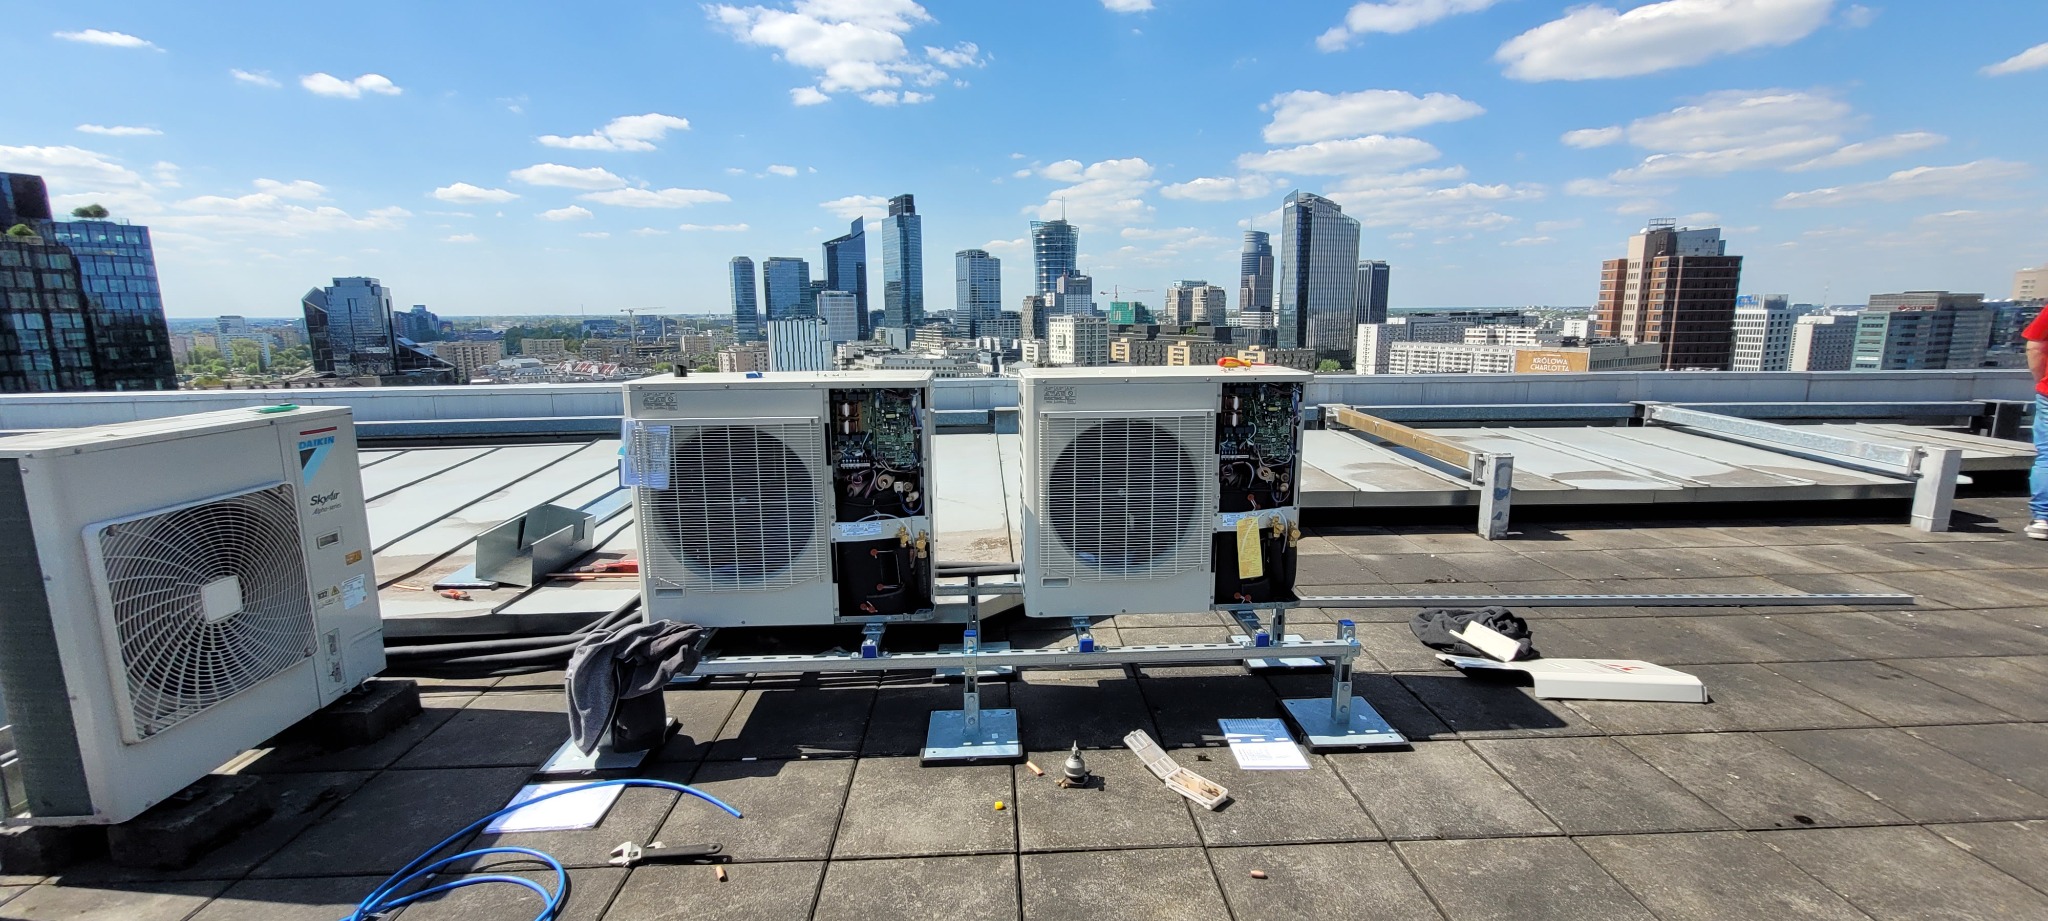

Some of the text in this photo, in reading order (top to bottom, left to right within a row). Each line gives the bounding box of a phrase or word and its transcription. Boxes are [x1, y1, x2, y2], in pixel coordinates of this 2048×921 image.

[1532, 357, 1568, 365] KRÓLOWA
[1530, 364, 1569, 372] CHARLOTTA
[298, 436, 334, 449] DAIKIN
